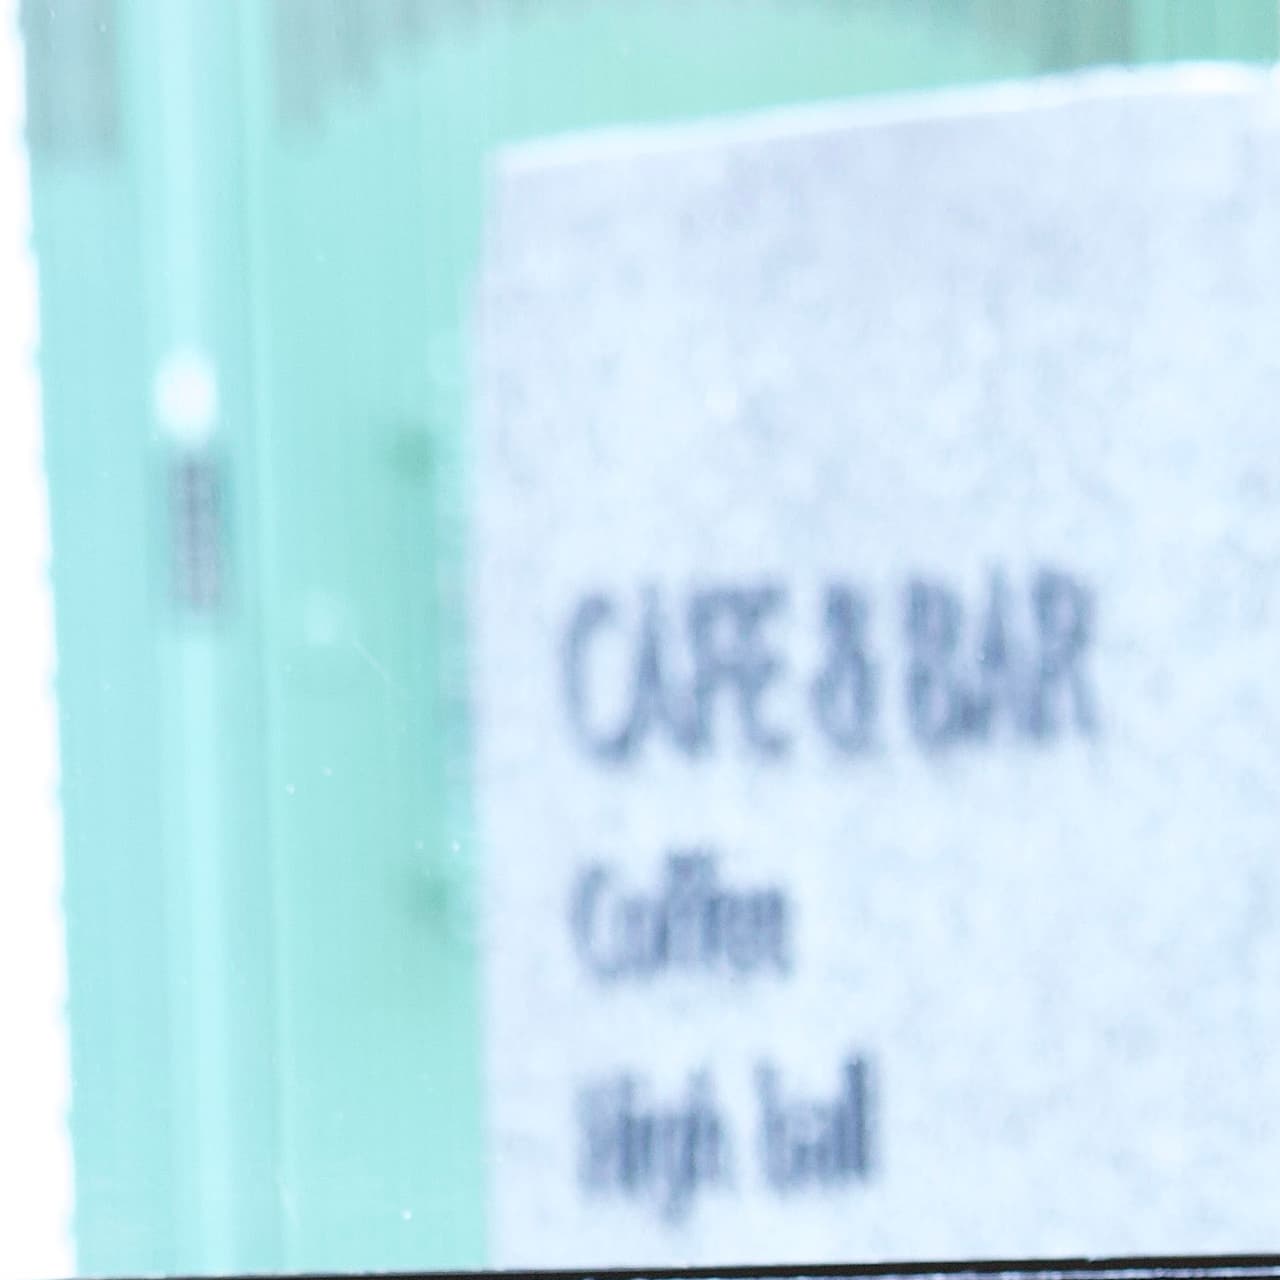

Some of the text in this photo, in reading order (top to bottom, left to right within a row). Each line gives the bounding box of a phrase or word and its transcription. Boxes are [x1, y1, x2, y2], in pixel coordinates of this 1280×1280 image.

[560, 578, 794, 764] CAFE
[900, 562, 1104, 748] BAR
[570, 846, 794, 984] Coffee
